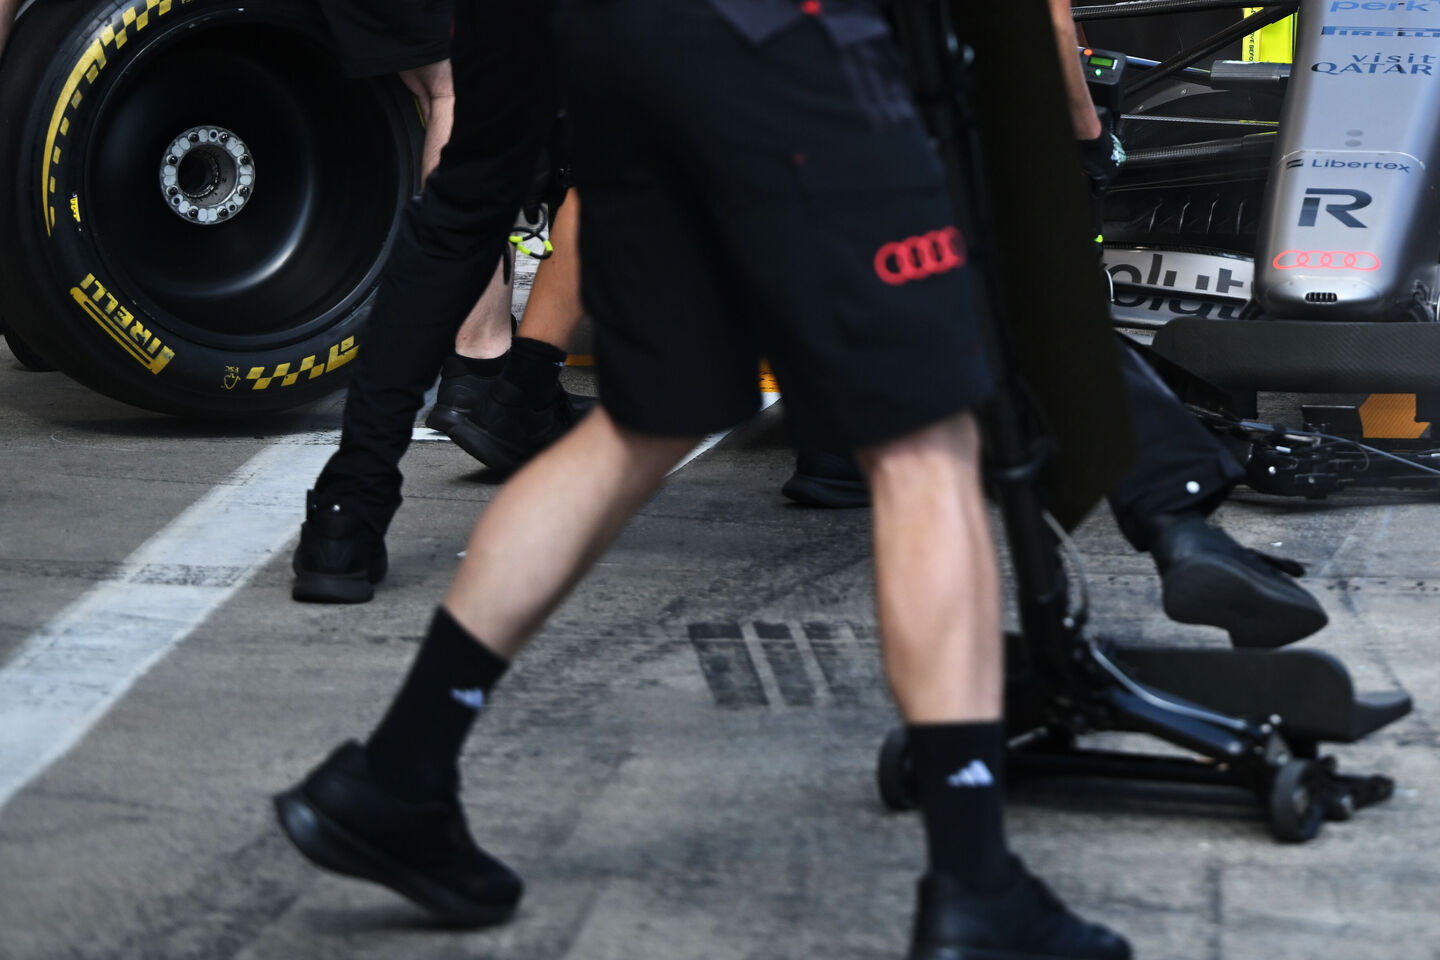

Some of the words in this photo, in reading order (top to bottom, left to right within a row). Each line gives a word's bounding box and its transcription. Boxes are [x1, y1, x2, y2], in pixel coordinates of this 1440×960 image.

[1352, 52, 1437, 64] visit
[1311, 61, 1433, 76] QATAR
[1312, 159, 1411, 174] Libertex
[1297, 188, 1373, 228] R
[70, 273, 175, 375] PIRELLI
